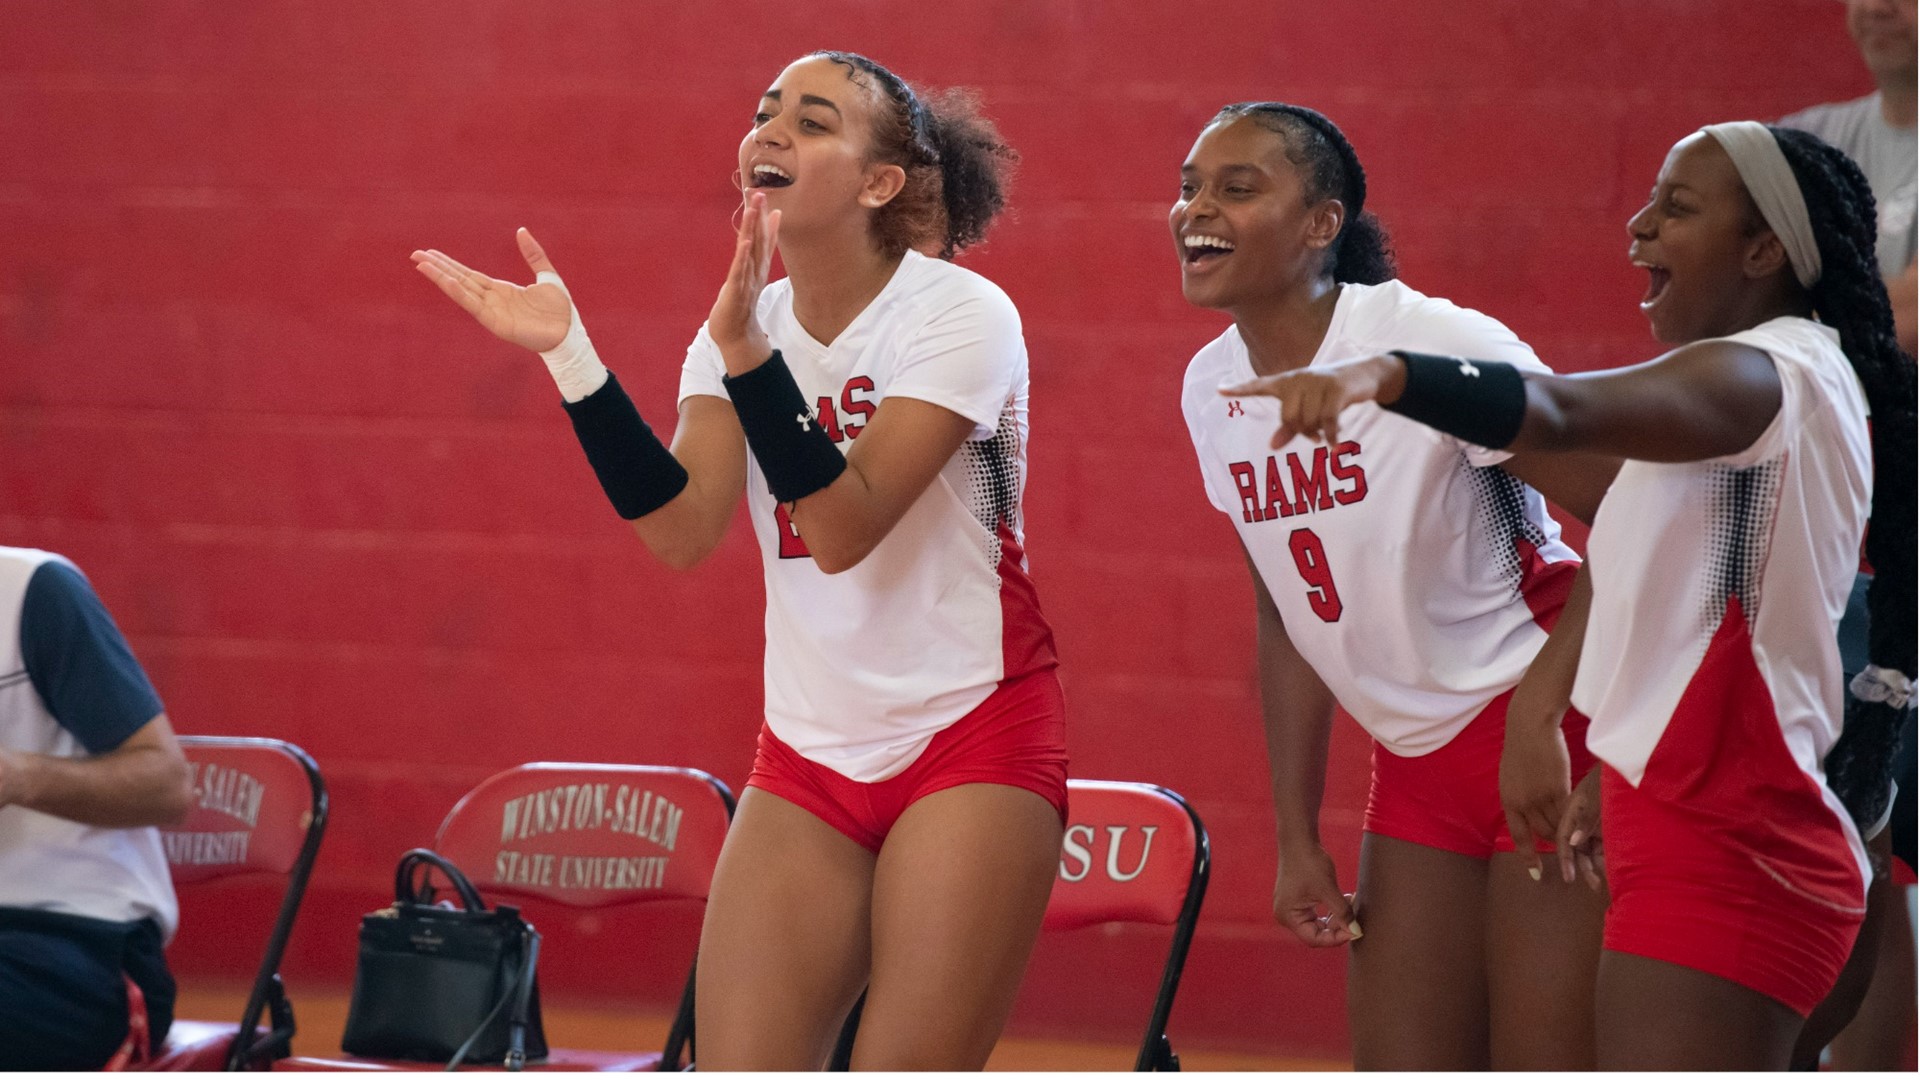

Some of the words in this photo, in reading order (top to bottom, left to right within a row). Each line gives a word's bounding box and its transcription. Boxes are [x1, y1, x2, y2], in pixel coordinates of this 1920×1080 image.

[1228, 440, 1369, 524] RAMS
[1288, 527, 1344, 623] 9
[161, 830, 250, 865] NIVERSITY
[501, 783, 685, 851] WINSTON-SALEM
[494, 850, 556, 885] STATE
[559, 856, 670, 890] UNIVERSITY
